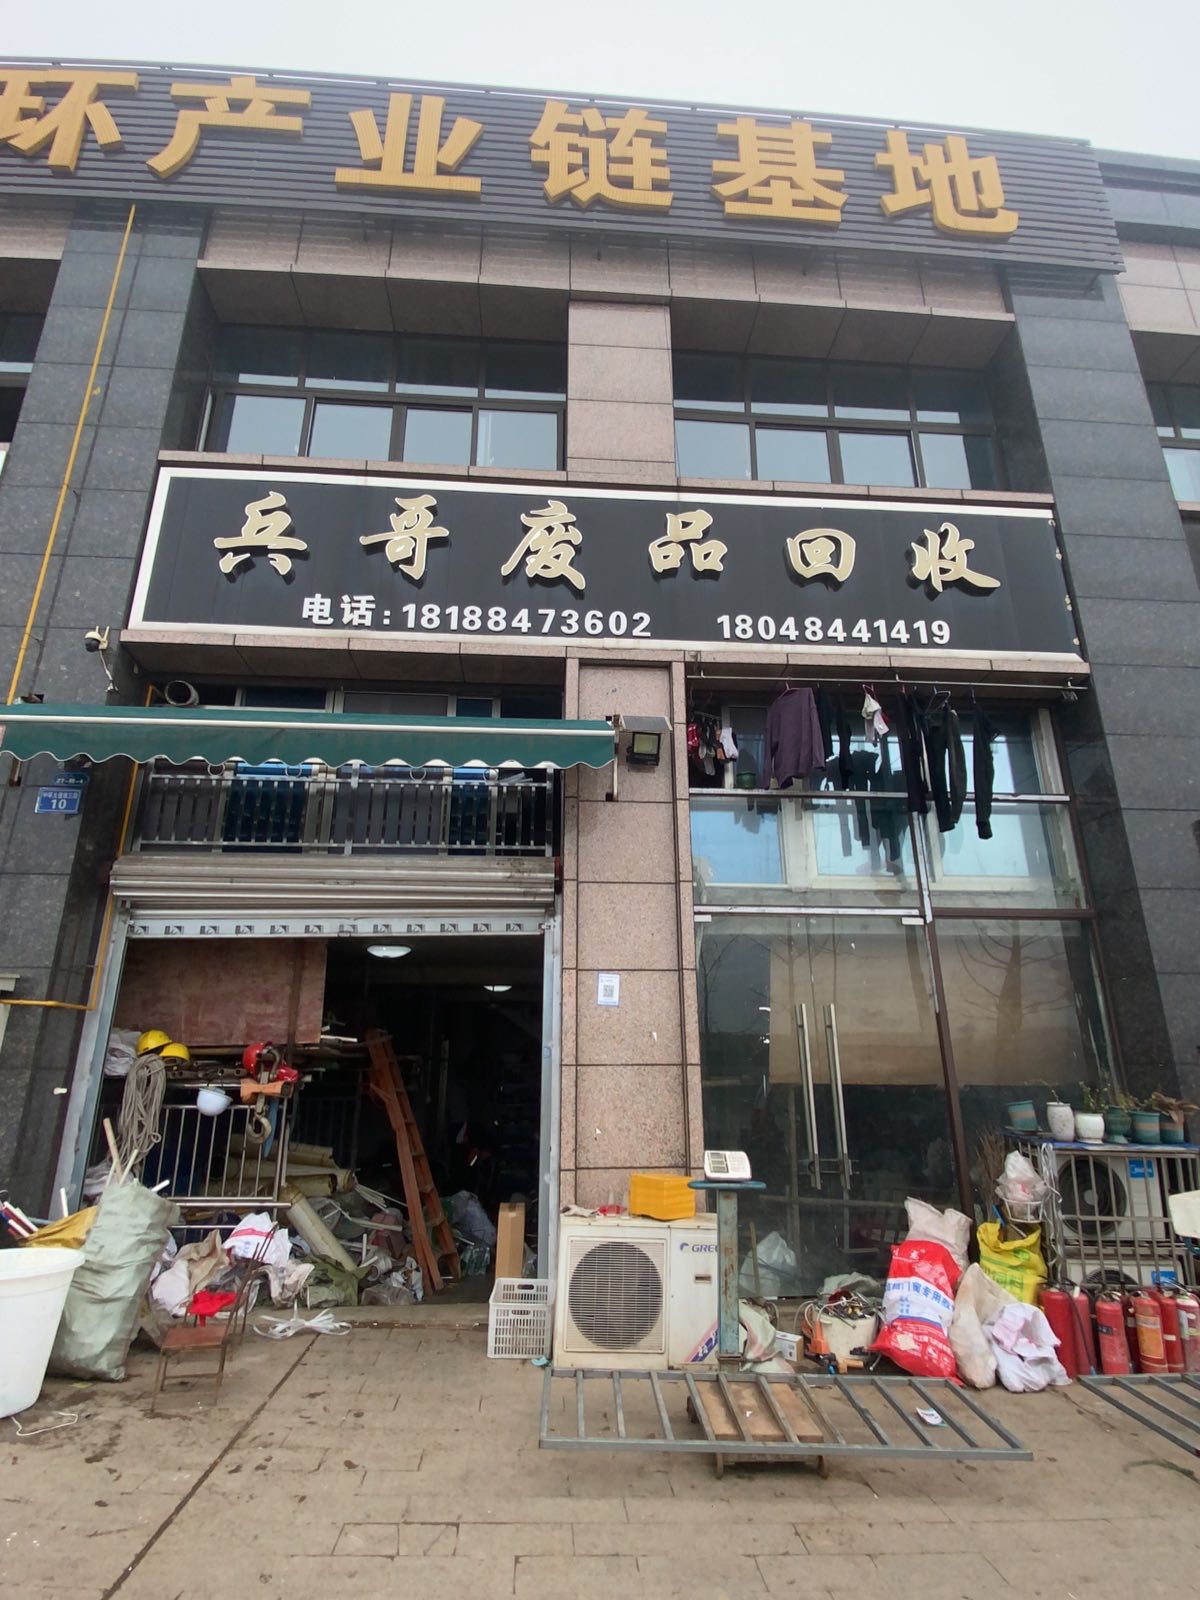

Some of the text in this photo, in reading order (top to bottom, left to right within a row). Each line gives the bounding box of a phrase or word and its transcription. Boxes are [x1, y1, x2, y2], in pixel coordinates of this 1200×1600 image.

[0, 68, 1019, 238] 环产业链基地
[213, 491, 1000, 592] 兵哥废品回收
[302, 593, 951, 645] 电话:18188473602 18048441419
[51, 799, 67, 809] 10
